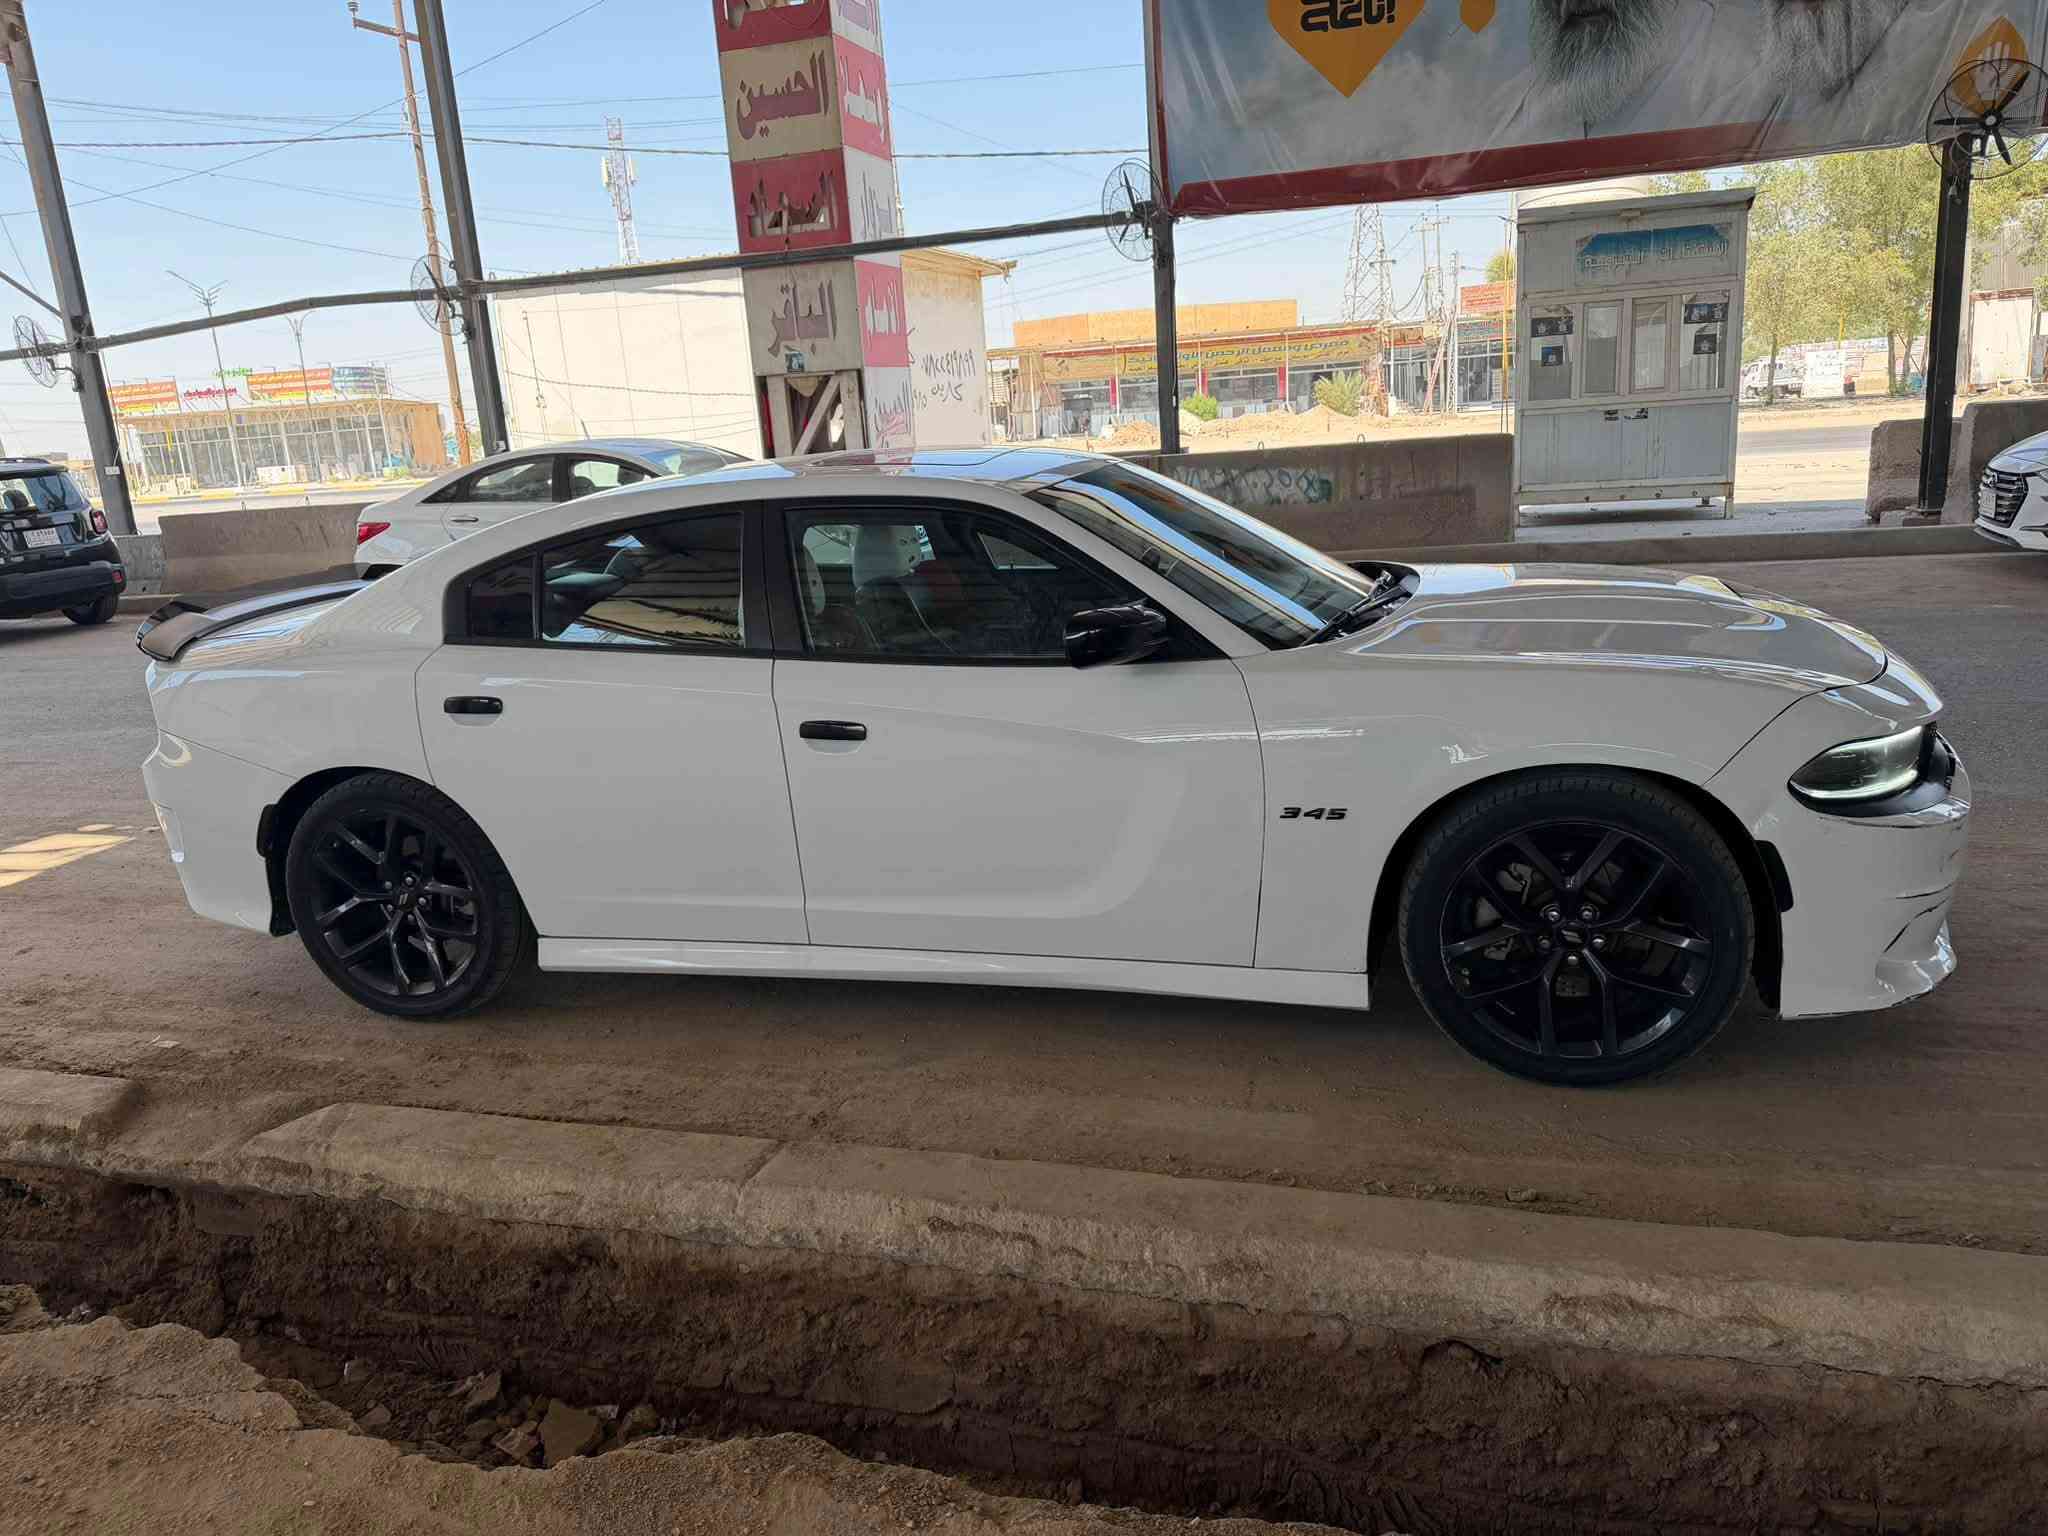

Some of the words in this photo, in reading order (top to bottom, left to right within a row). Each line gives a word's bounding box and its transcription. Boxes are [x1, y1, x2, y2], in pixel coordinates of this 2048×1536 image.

[736, 49, 831, 140] الحسين
[768, 279, 837, 358] الباقر
[1279, 806, 1348, 820] 345
